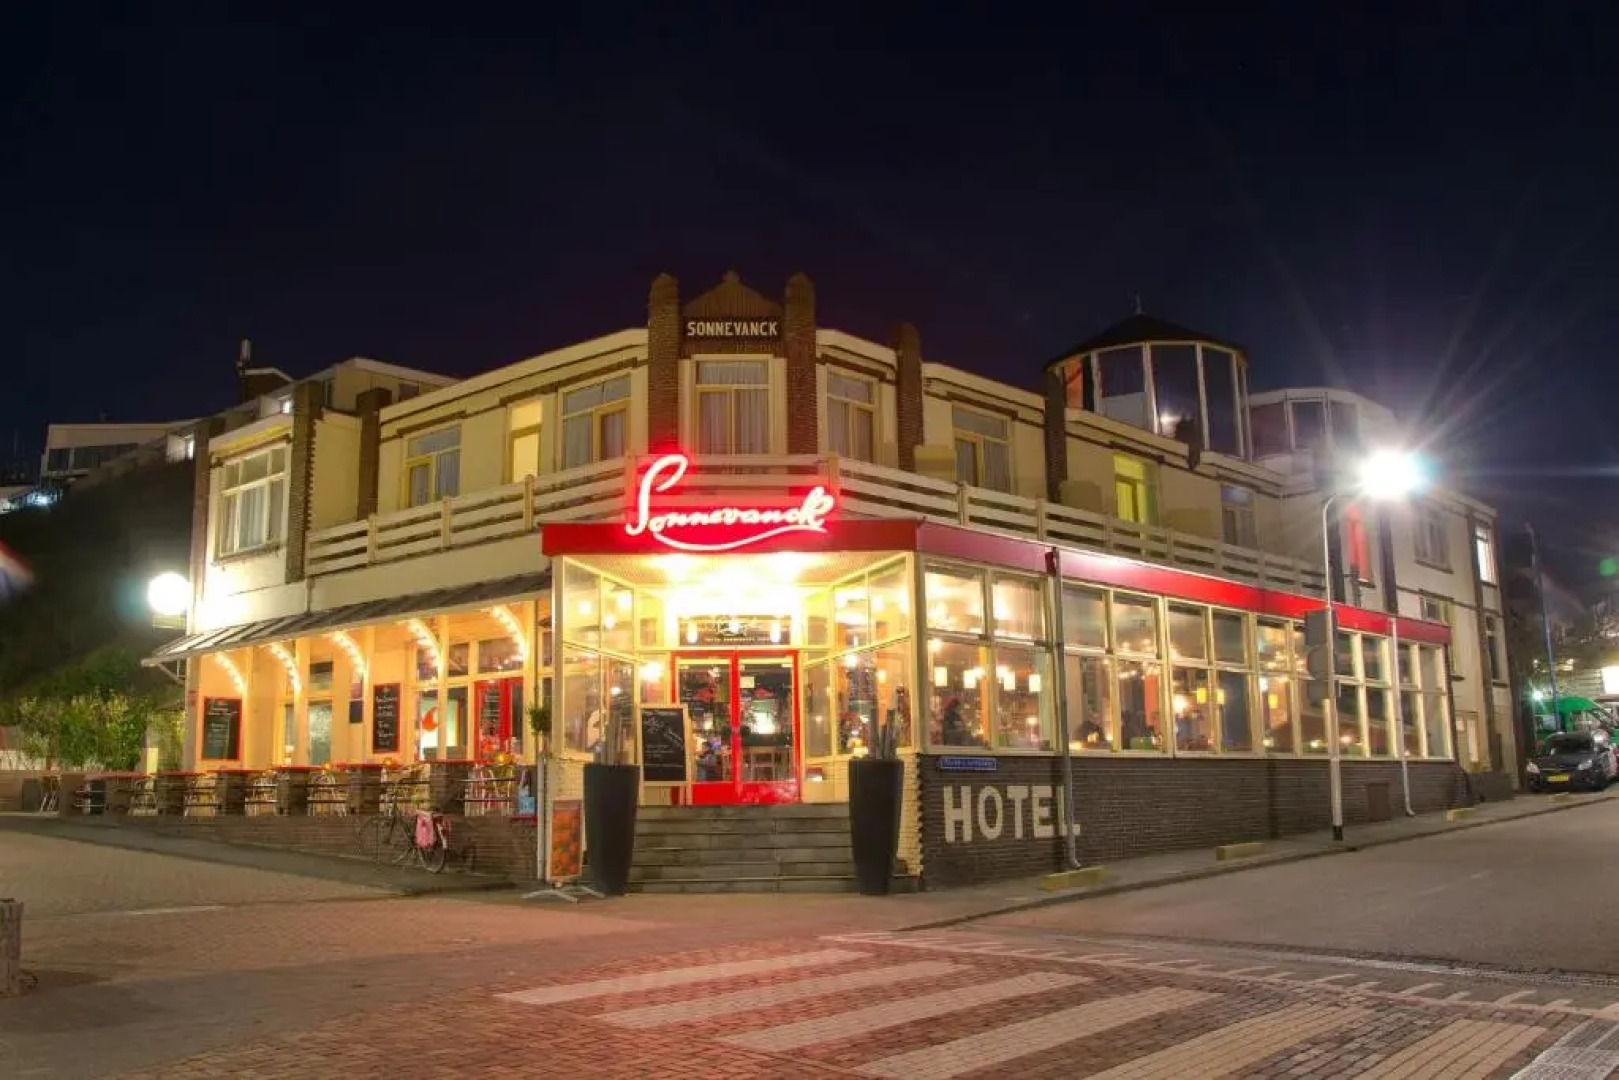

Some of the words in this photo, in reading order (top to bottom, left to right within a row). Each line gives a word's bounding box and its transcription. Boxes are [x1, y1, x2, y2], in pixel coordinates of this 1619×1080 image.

[687, 321, 778, 336] SONNEVANCK
[625, 454, 834, 550] Sonnevanck
[943, 785, 1081, 843] HOTEL
